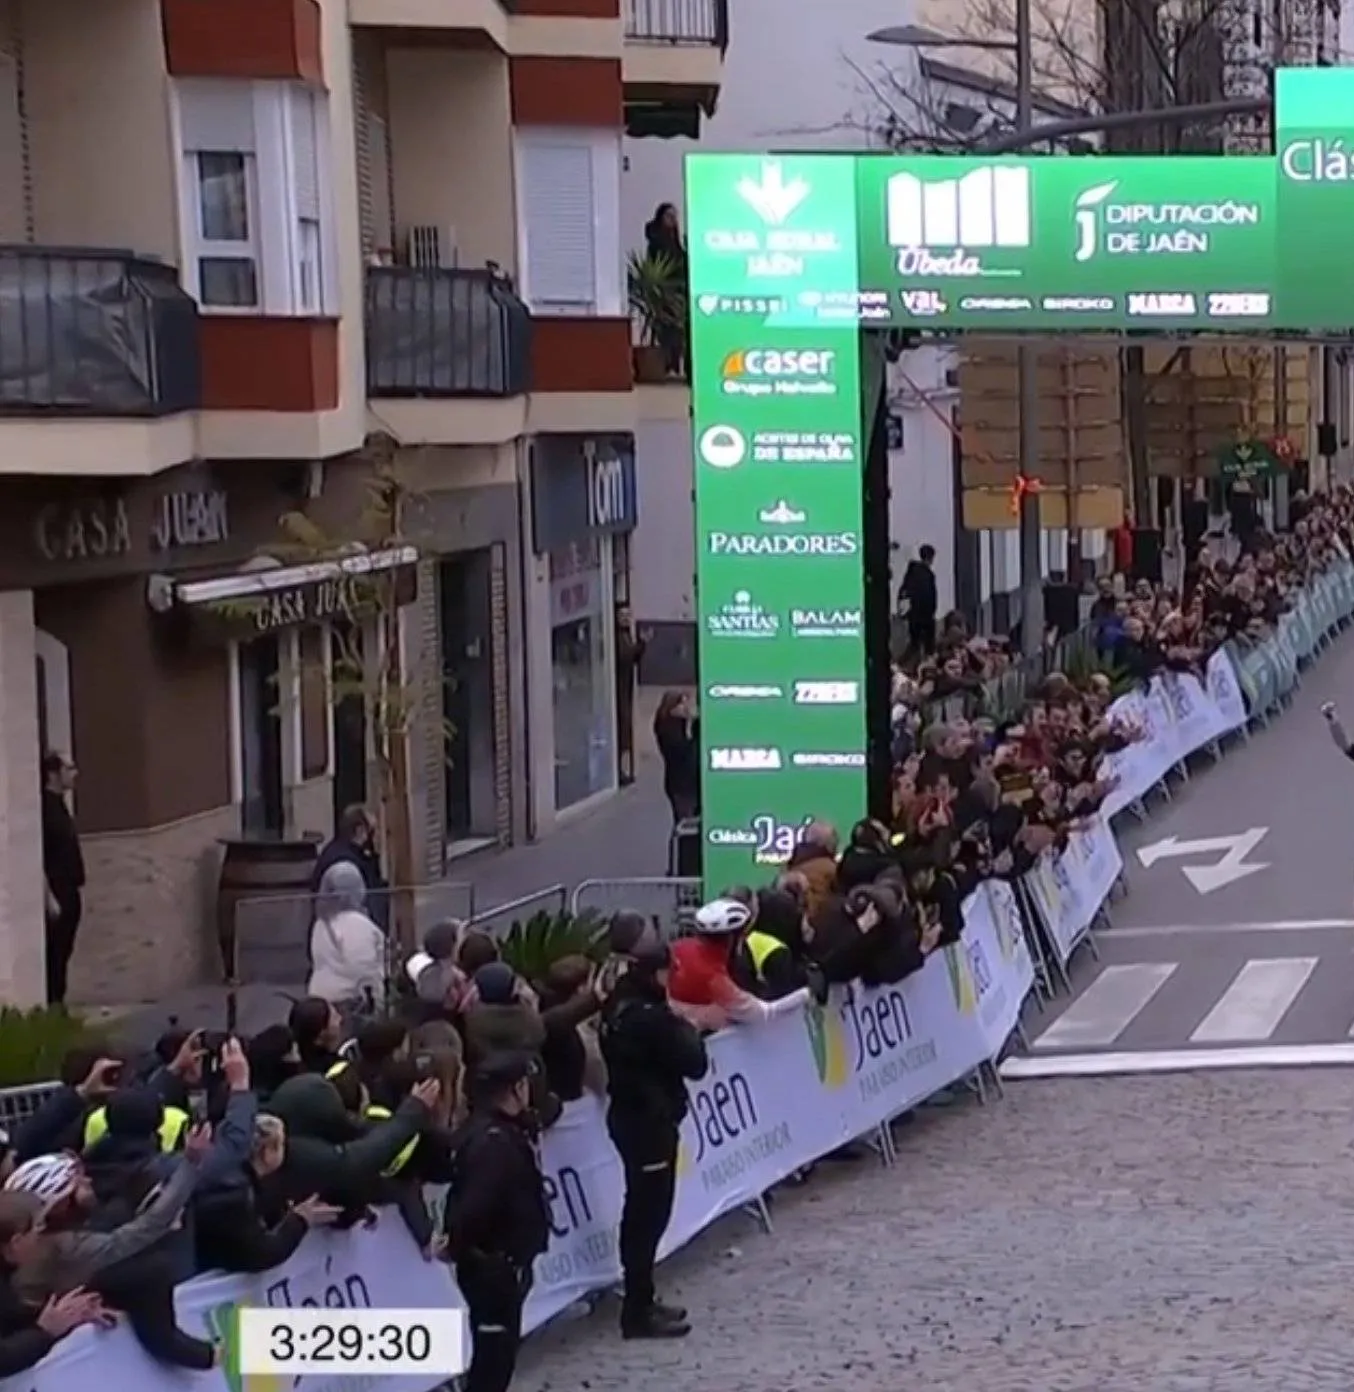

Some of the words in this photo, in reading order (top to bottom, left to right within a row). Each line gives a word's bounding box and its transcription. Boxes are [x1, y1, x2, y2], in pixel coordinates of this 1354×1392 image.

[1106, 201, 1258, 225] DIPUTACIÓN
[1107, 232, 1141, 253] DE
[1142, 226, 1208, 253] JAÉN
[745, 350, 836, 375] caser
[710, 532, 857, 554] PARADORES
